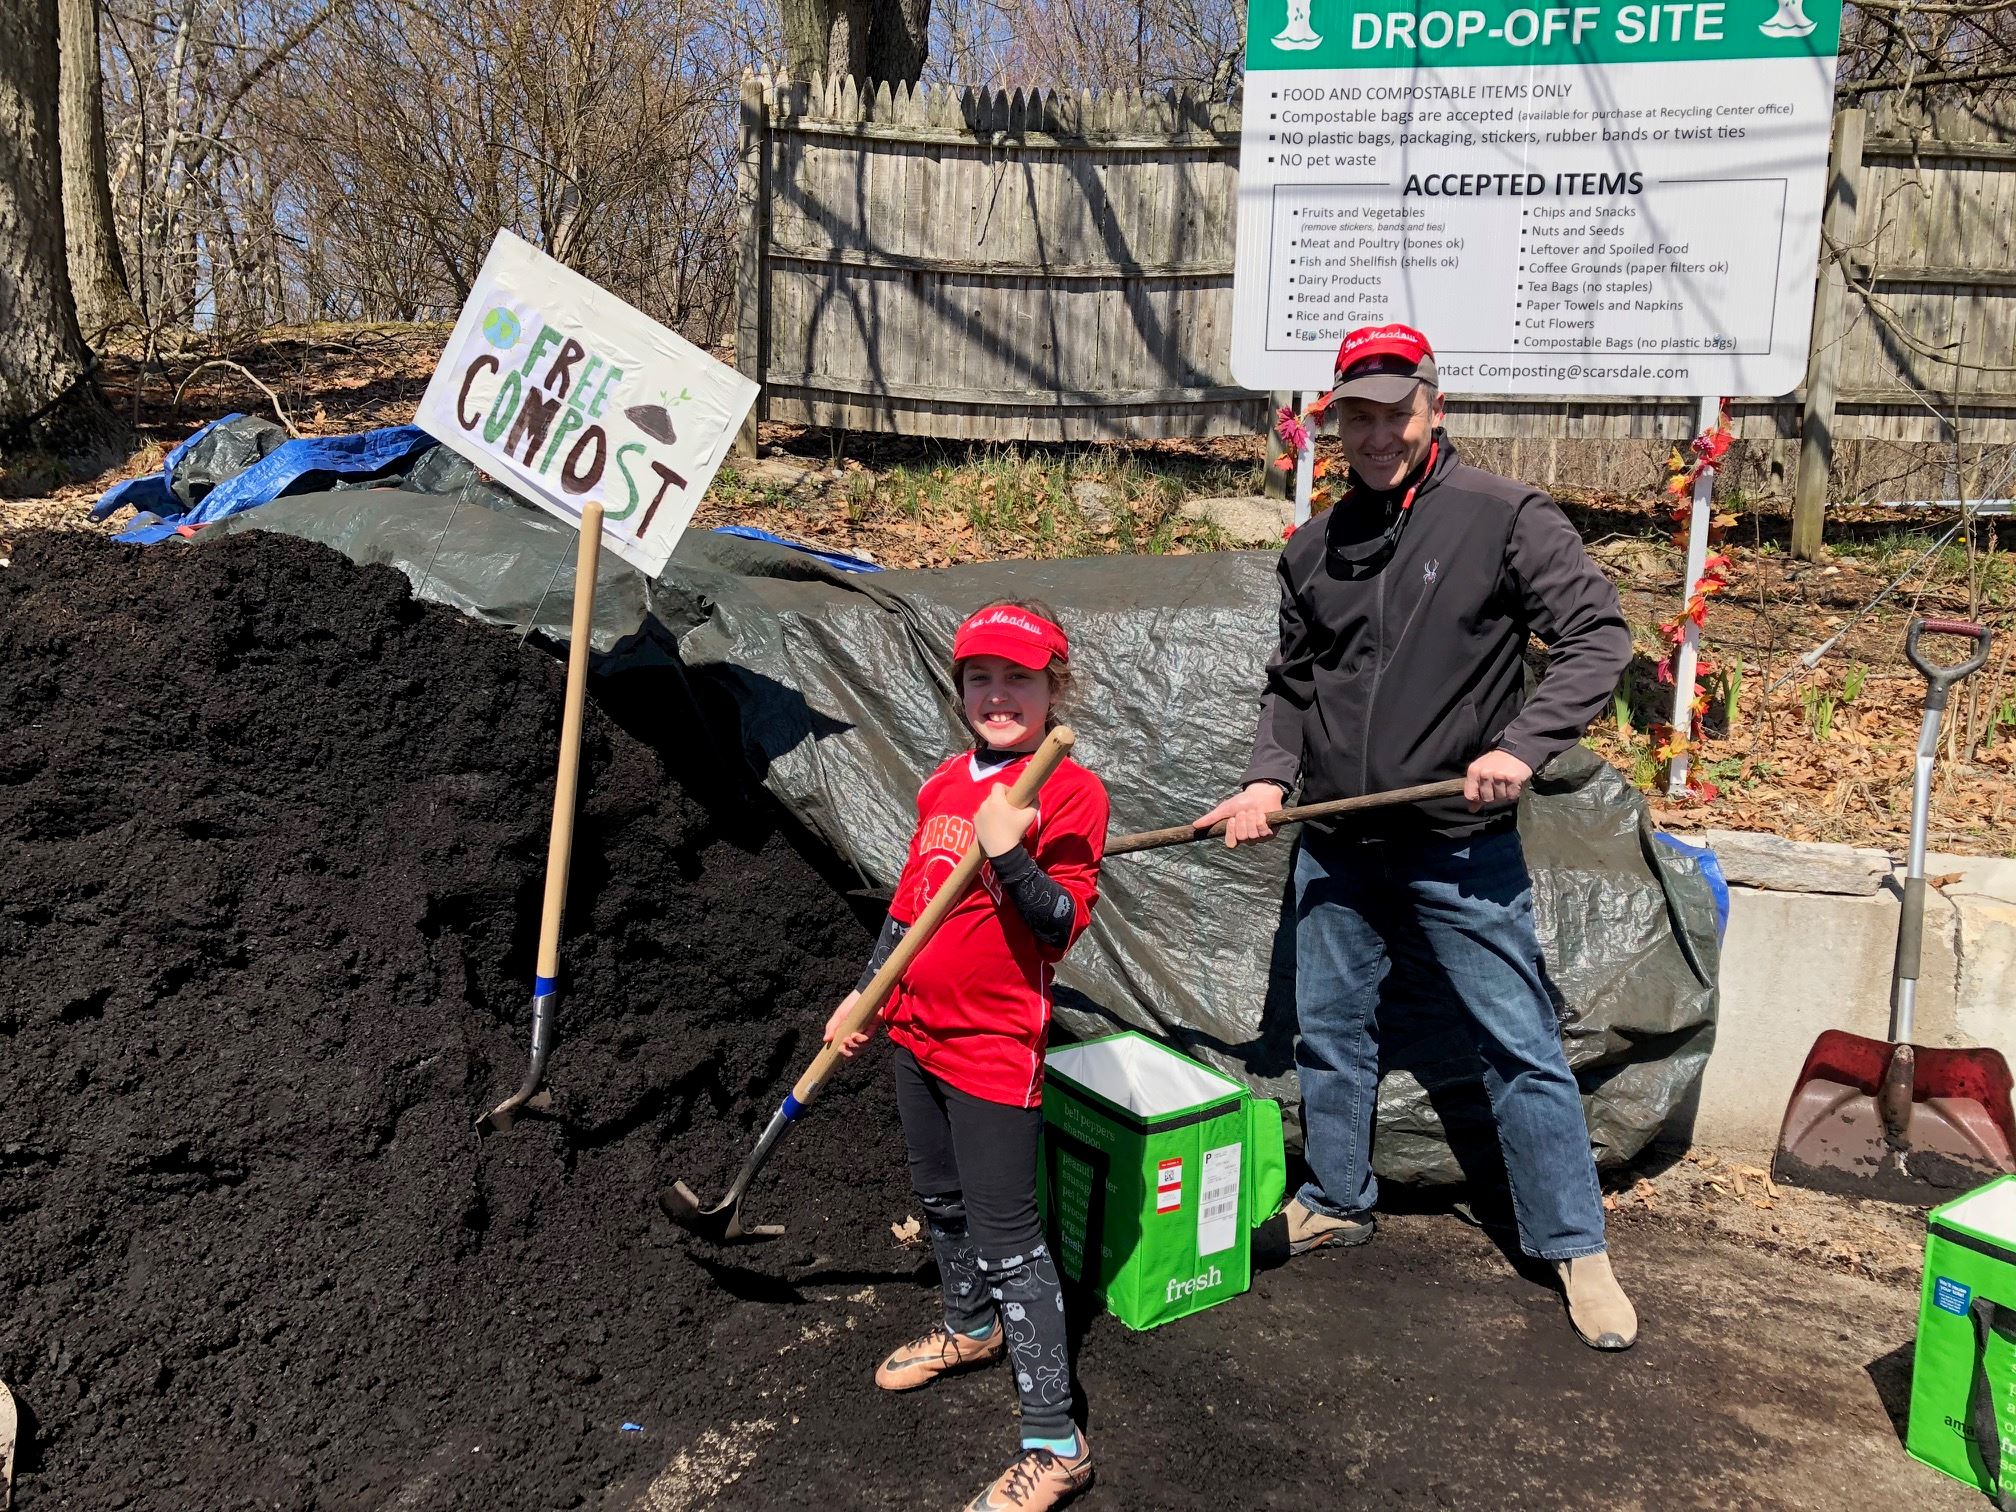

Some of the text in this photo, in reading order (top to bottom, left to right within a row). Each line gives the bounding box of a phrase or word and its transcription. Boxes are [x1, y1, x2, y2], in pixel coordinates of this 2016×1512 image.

[1352, 4, 1724, 49] DROP-OFF SITE
[1284, 84, 1572, 101] FOOD AND COMPOSTABLE ITEMS ONLY
[1282, 104, 1794, 125] Compostable bags are accepted (available for purchase at Recycling Center office)
[1282, 125, 1745, 147] NO plastic bags, packaging, stickers, rubber bands or twist ties
[1281, 154, 1376, 168] NO pet waste
[1403, 172, 1643, 196] ACCEPTED ITEMS
[1302, 207, 1424, 220] Fruits and Vegetables
[1534, 206, 1636, 219] Chips and Snacks
[1301, 223, 1445, 233] (remove stickers, bands and ties)
[1532, 225, 1624, 236] Nuts and Seeds
[1301, 238, 1464, 250] Meat and Poultry (bones ok)
[1531, 243, 1688, 256] Leftover and Spoiled Food
[1300, 256, 1458, 269] Fish and Shellfish (shells ok)
[1530, 261, 1728, 275] Coffee Grounds (paper filters ok)
[1299, 274, 1381, 287] Dairy Products
[1528, 281, 1652, 294] Tea Bags (no staples)
[1298, 292, 1388, 303] Bread and Pasta
[1527, 300, 1683, 312] Paper Towels and Napkins
[1297, 311, 1383, 321] Rice and Grains
[1526, 318, 1594, 329] Cut Flowers
[1365, 328, 1418, 344] Meadow
[1524, 336, 1737, 350] Compostable Bags (no plastic bags)
[522, 324, 623, 419] FREE
[1438, 364, 1689, 381] ntact Composting@scarsdale.com
[457, 354, 688, 539] COMPOST
[985, 610, 1042, 635] Meadow
[919, 814, 974, 858] ARSD
[1064, 1103, 1116, 1142] bell peppers
[1063, 1121, 1101, 1149] shampoo
[1205, 1153, 1212, 1164] P
[1062, 1169, 1091, 1196] sausag
[1076, 1191, 1089, 1209] foo
[1061, 1230, 1083, 1254] fresh
[1165, 1265, 1222, 1303] fresh
[1944, 1415, 1976, 1437] ama
